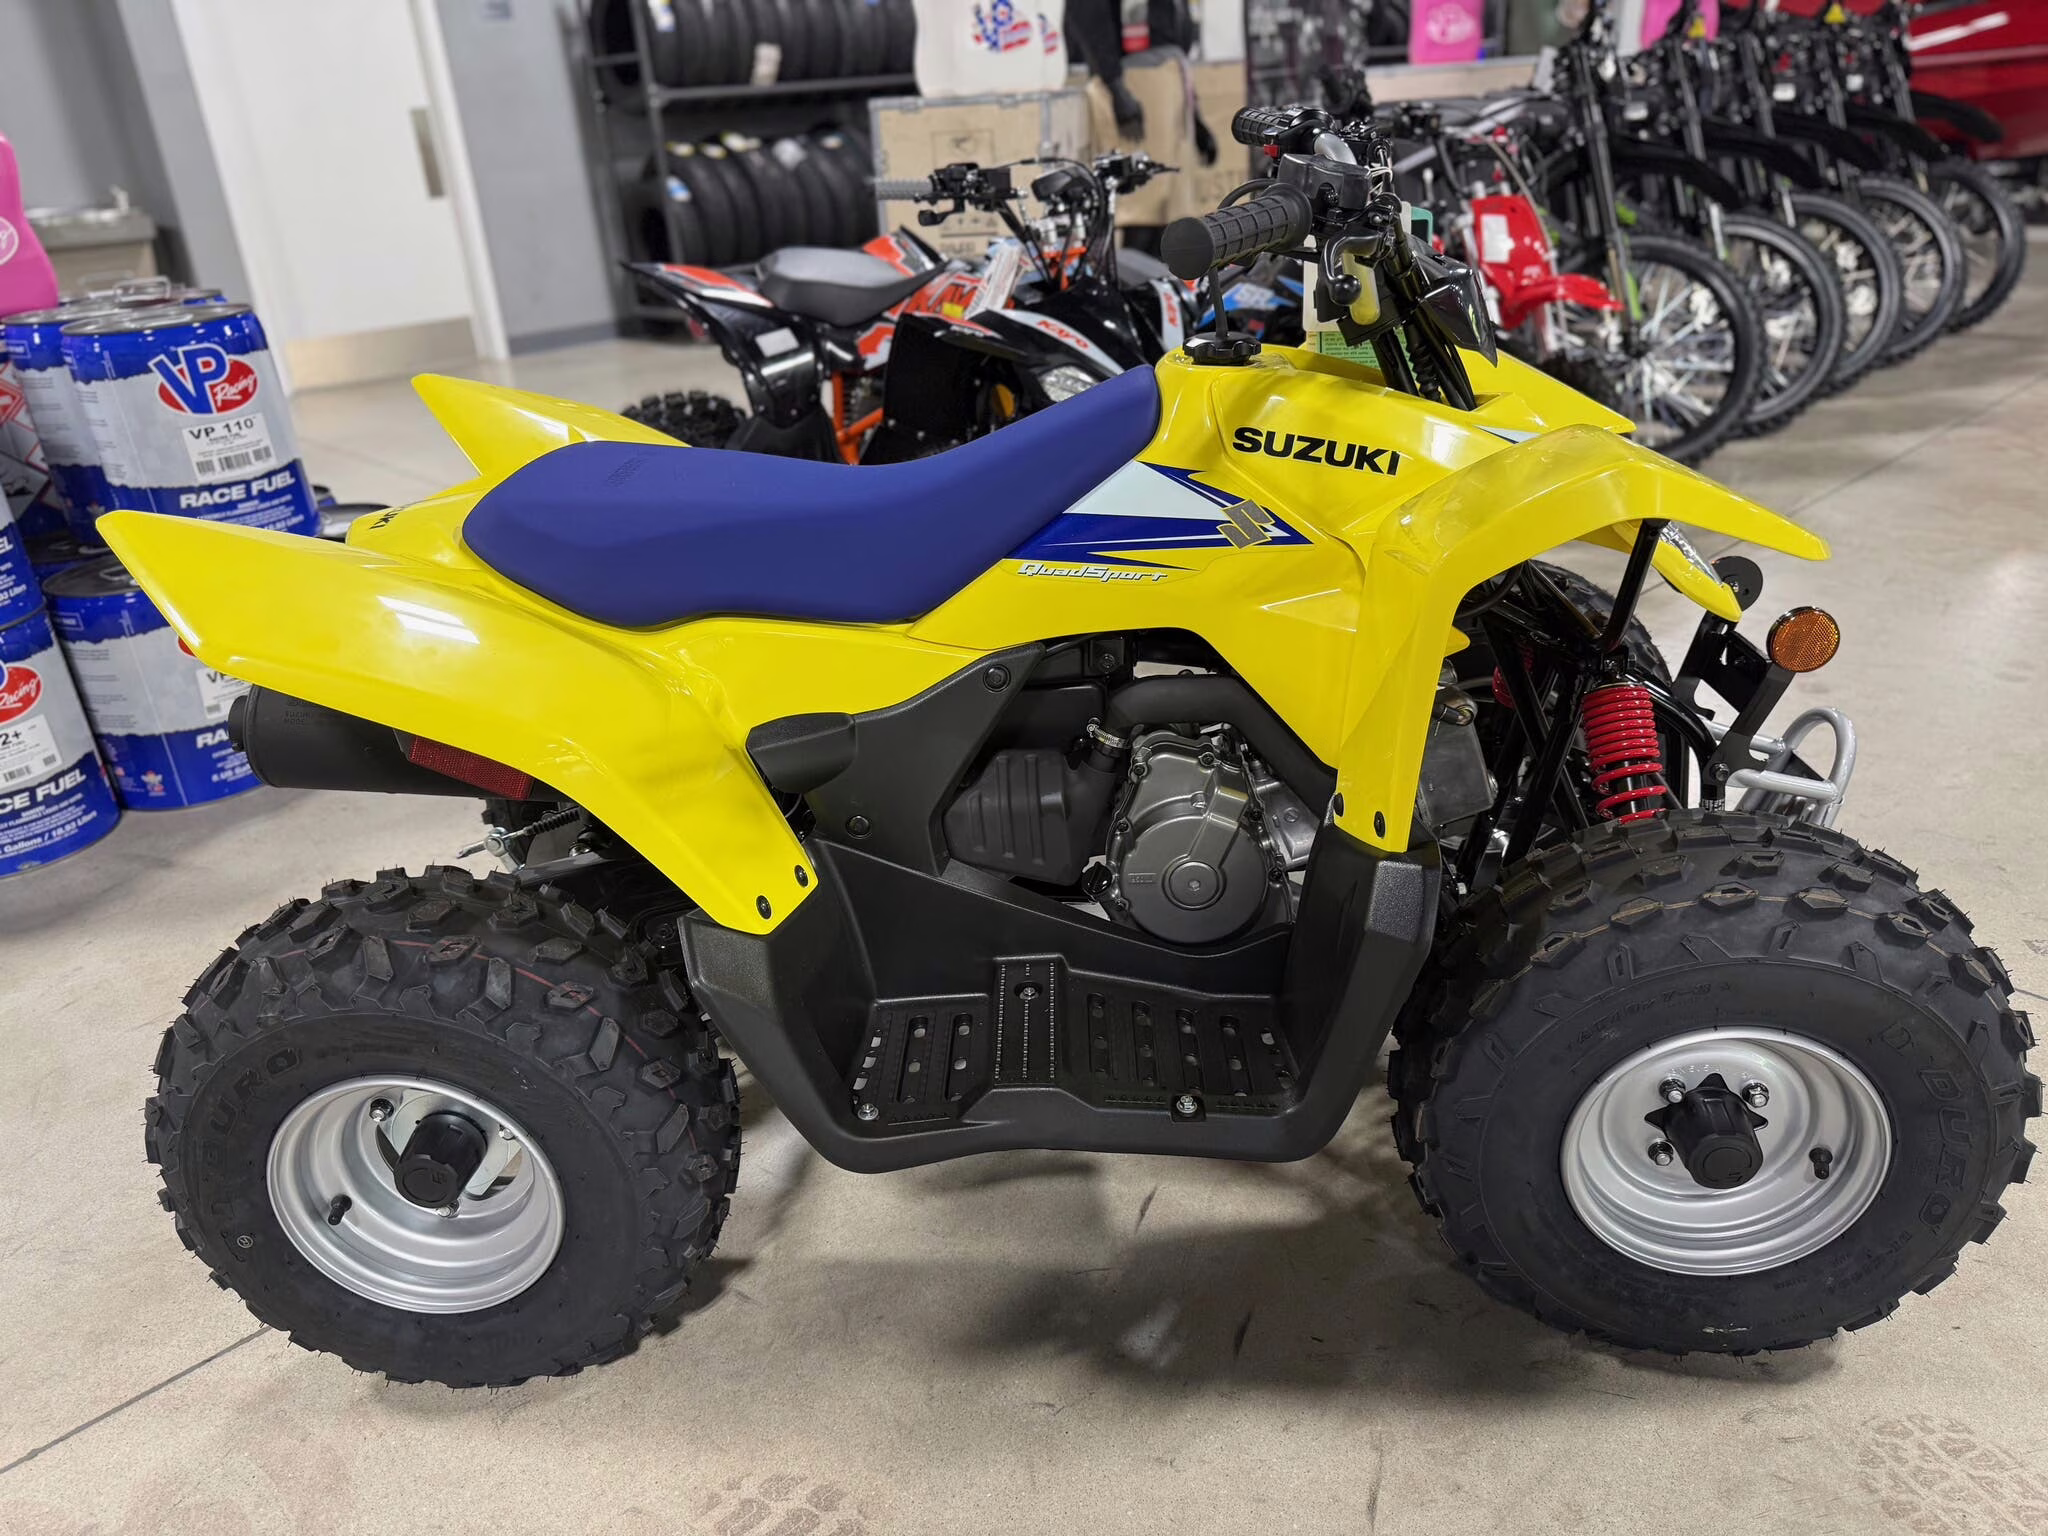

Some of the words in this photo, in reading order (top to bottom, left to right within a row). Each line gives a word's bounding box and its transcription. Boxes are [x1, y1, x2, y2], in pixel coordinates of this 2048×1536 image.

[147, 343, 230, 415] VP
[212, 373, 259, 408] Racing
[188, 426, 215, 441] VP
[223, 418, 254, 434] 110
[1232, 426, 1400, 476] SUZUKI
[180, 484, 247, 509] RACE
[250, 470, 296, 497] FUEL
[1017, 562, 1169, 583] QuadSport
[36, 768, 87, 803] FUEL
[1916, 1067, 1975, 1229] DURO
